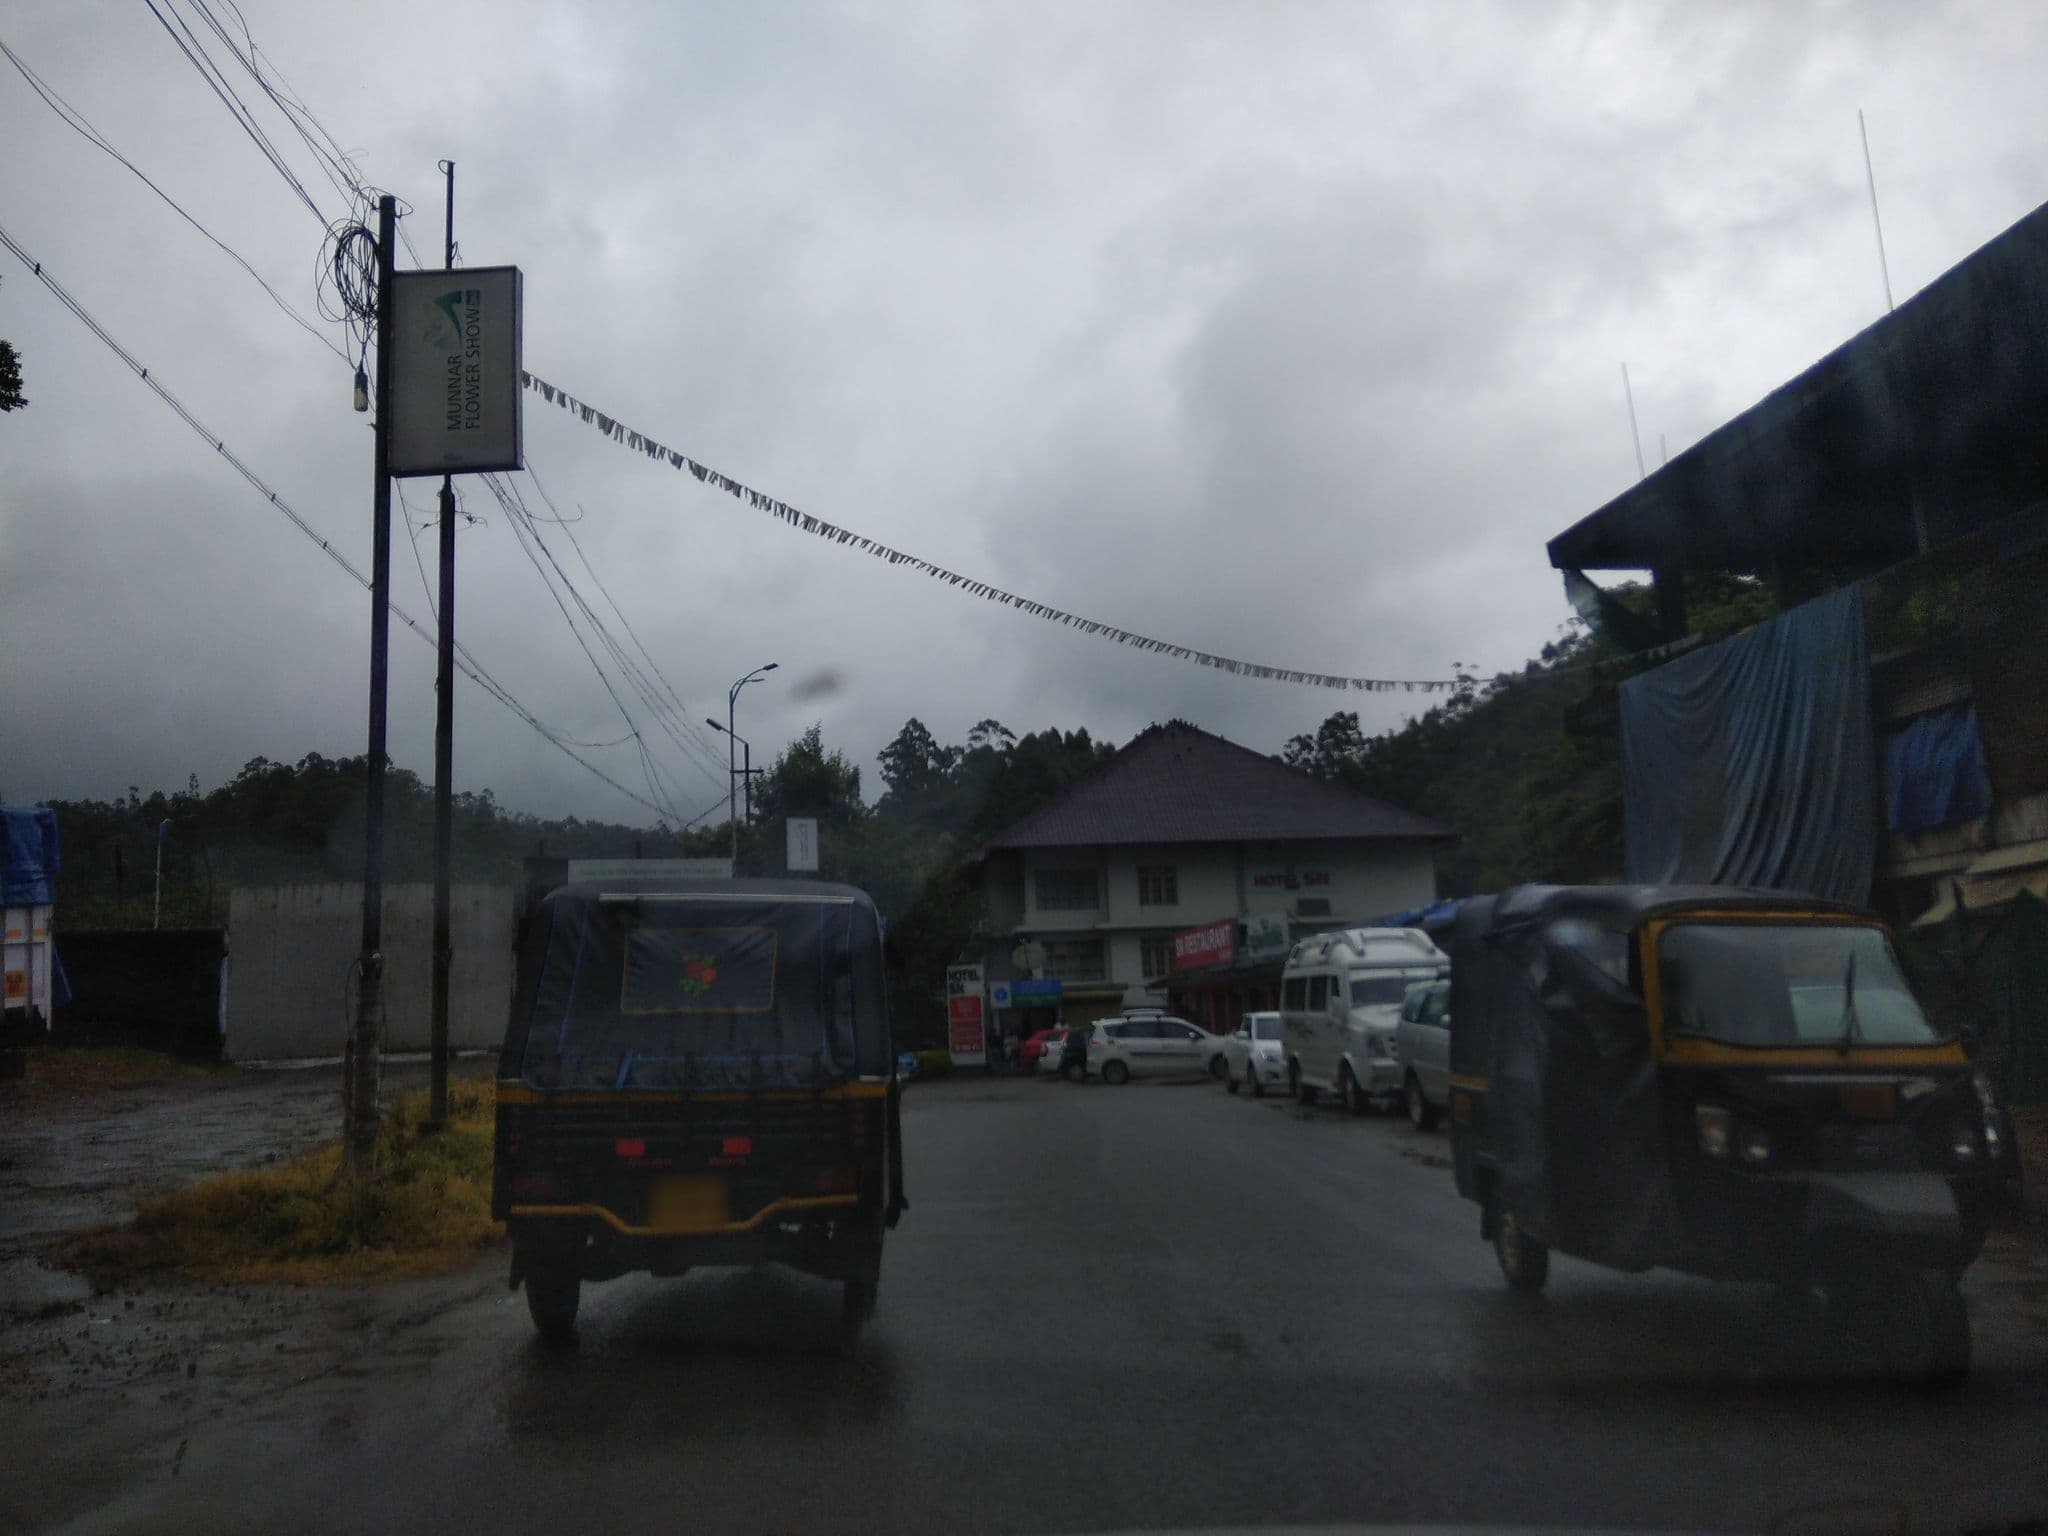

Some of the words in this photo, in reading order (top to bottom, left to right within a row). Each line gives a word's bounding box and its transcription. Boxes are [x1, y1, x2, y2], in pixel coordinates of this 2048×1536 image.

[465, 306, 481, 358] SHOW
[447, 354, 463, 431] MUNNAR
[465, 364, 481, 429] FLOWER
[1184, 924, 1232, 955] RESTAURANT
[947, 967, 978, 981] HOTEL
